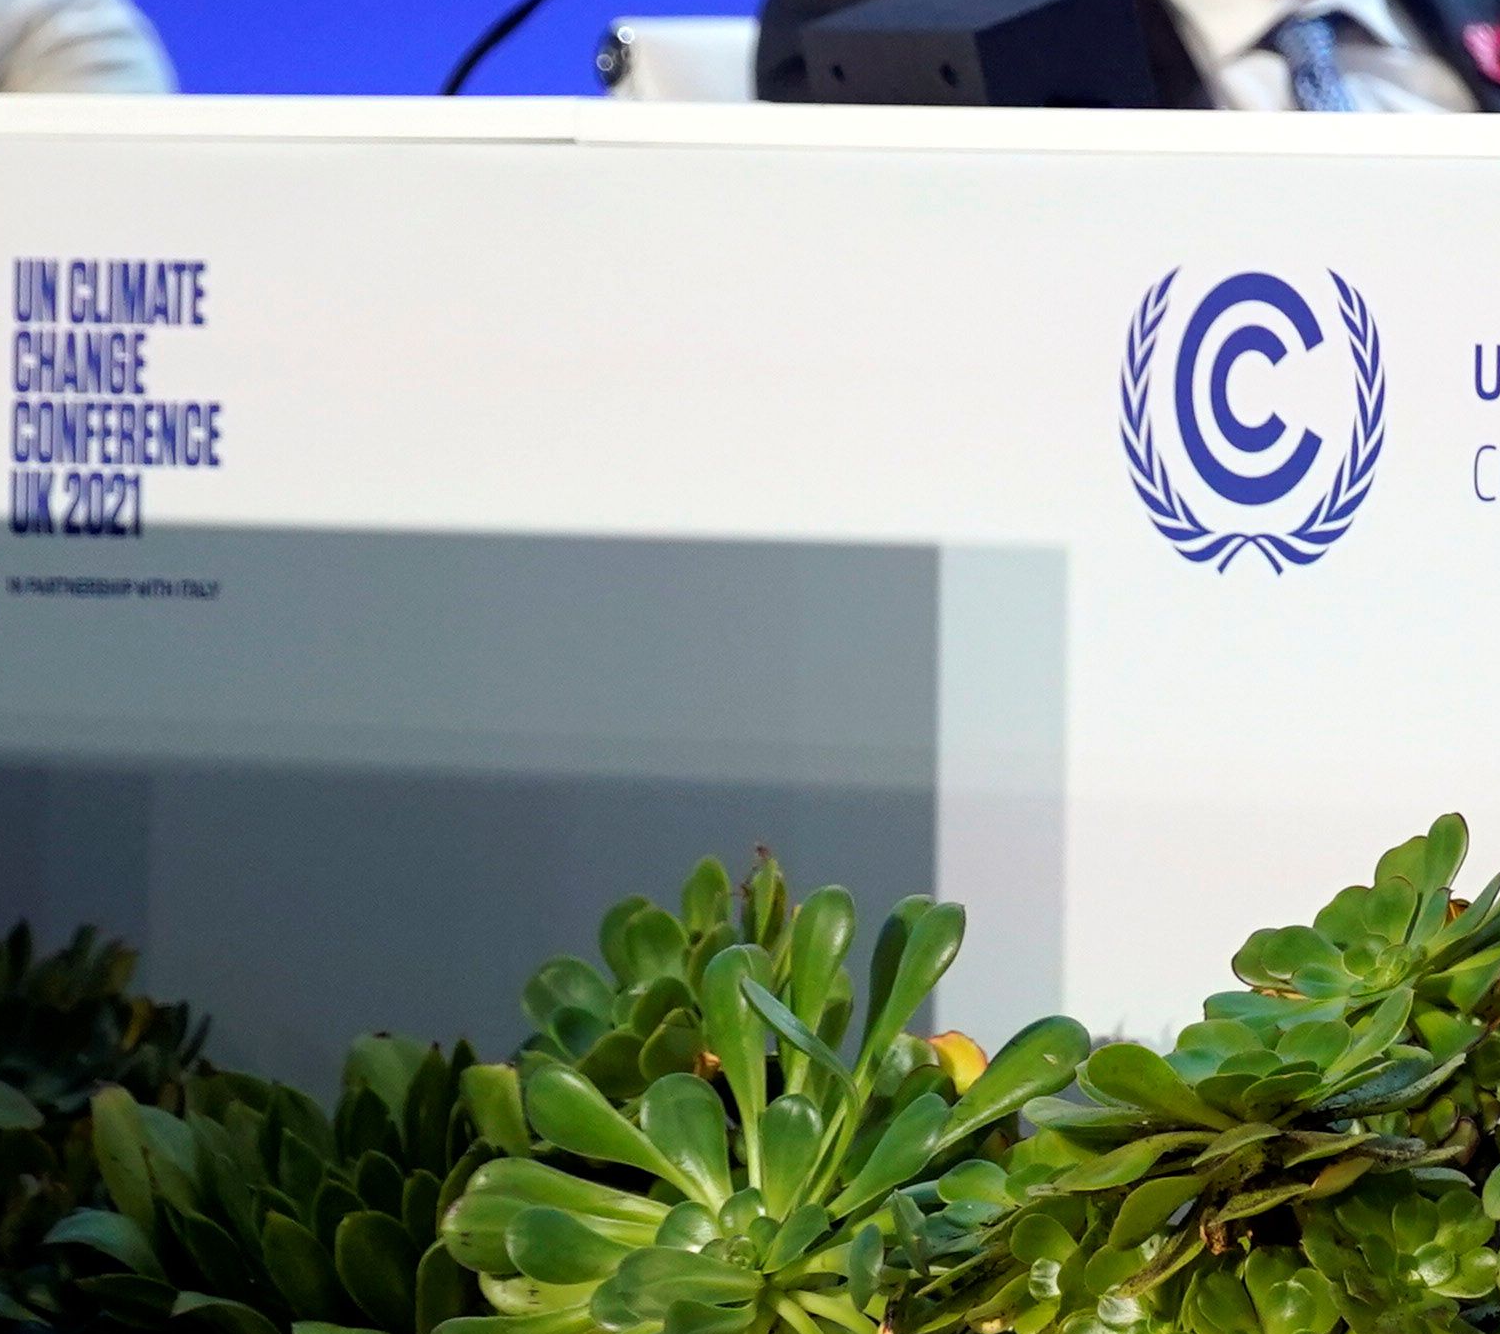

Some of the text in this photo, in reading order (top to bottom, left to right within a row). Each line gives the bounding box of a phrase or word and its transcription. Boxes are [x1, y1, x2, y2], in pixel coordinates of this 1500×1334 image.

[14, 260, 206, 326] UN CLIMATE
[13, 330, 146, 395] CHANGE
[12, 400, 221, 466] CONFERENCE
[11, 471, 141, 536] UK 2021
